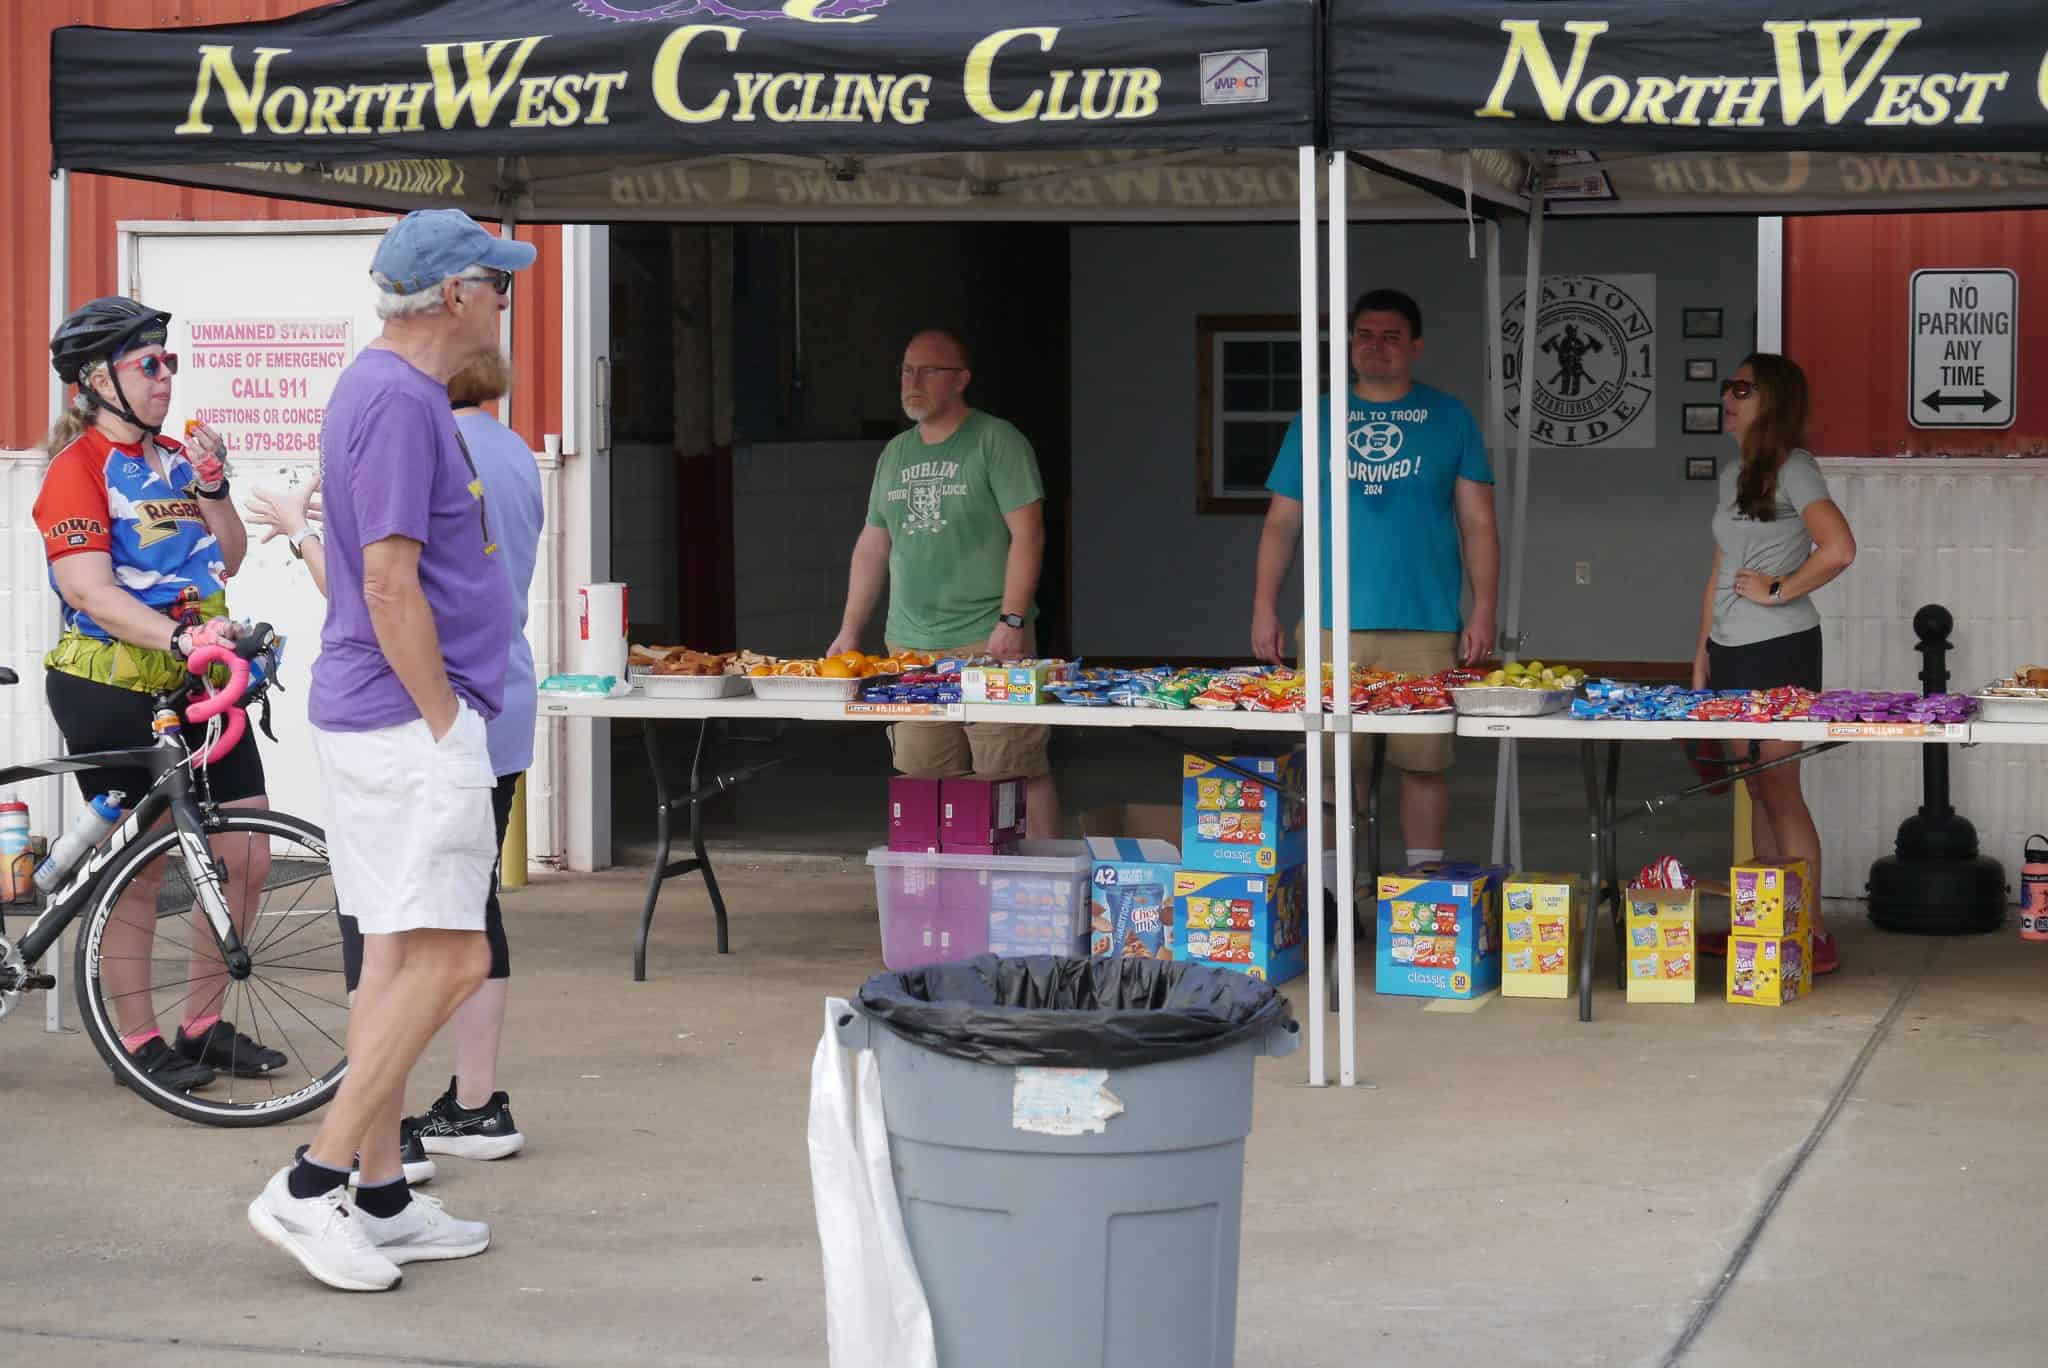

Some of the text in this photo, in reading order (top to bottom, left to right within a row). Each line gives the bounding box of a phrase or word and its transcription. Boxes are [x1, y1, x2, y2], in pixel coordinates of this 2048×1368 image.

[174, 24, 1162, 135] NORTHWEST CYCLING CLUB
[1474, 17, 2010, 127] NORTHWEST
[1949, 286, 1978, 310] NO
[191, 323, 346, 341] UNMANNED STATION
[1918, 311, 2009, 335] PARKING
[1944, 340, 1982, 361] ANY
[192, 352, 345, 368] IN CASE OF EMERGENCY
[1940, 366, 1985, 387] TIME
[231, 377, 308, 399] CALL 911
[195, 408, 325, 424] QUESTIONS OR CONCE
[1347, 409, 1428, 423] AIL TO TROOP
[902, 461, 959, 484] DUBLIN
[1347, 456, 1421, 482] URVIVED!
[144, 502, 201, 520] RAGBR
[51, 519, 102, 537] IOWA
[1261, 851, 1272, 860] 50
[1095, 868, 1116, 885] 42
[1131, 906, 1160, 922] Chex
[1455, 976, 1466, 986] 50
